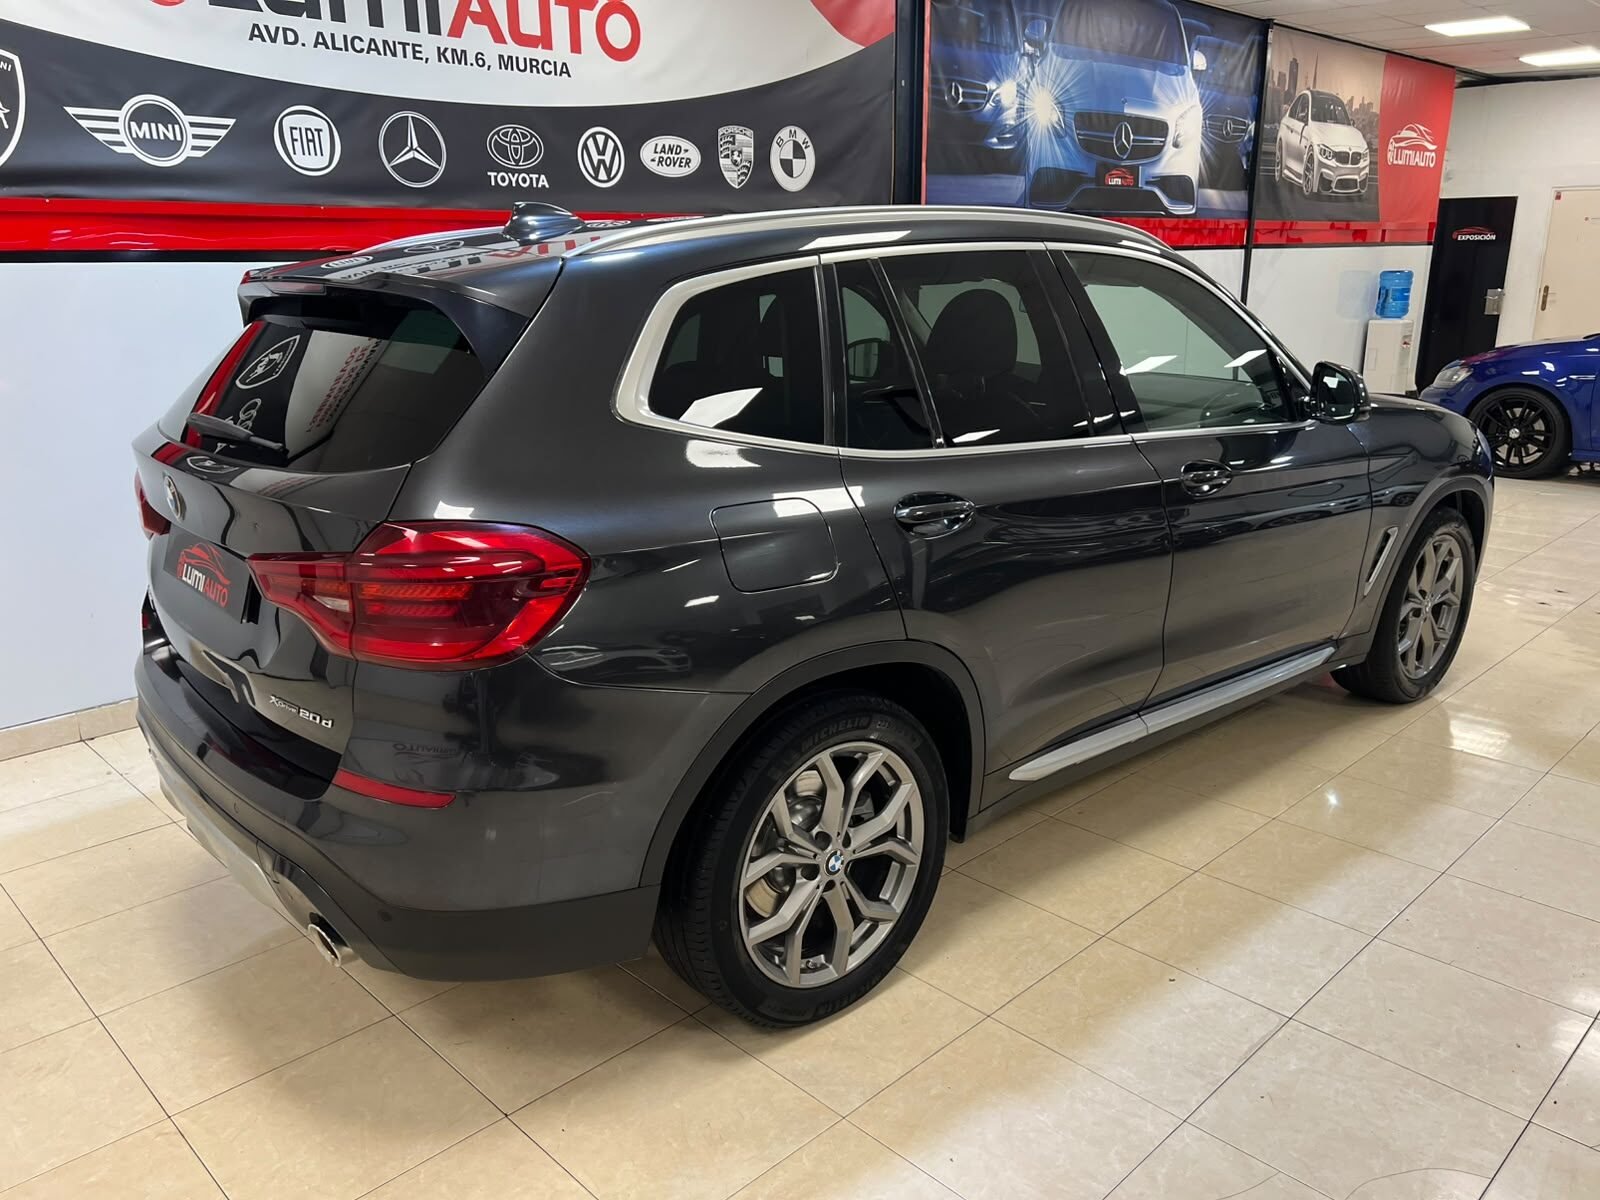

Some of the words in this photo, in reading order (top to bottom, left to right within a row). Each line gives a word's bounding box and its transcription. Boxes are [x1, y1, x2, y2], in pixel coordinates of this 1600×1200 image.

[249, 23, 306, 48] AVD.
[313, 32, 430, 64] ALICANTE,
[436, 46, 492, 71] KM.6,
[498, 54, 572, 78] MURCIA
[130, 121, 182, 142] MINI
[289, 126, 324, 157] FIAT
[653, 143, 682, 155] LAND
[657, 157, 692, 168] ROVER
[487, 171, 549, 188] TOYOTA
[1457, 233, 1496, 241] EXPOSICIÓN
[182, 563, 228, 608] LUMIAUTO
[299, 708, 333, 728] 20d
